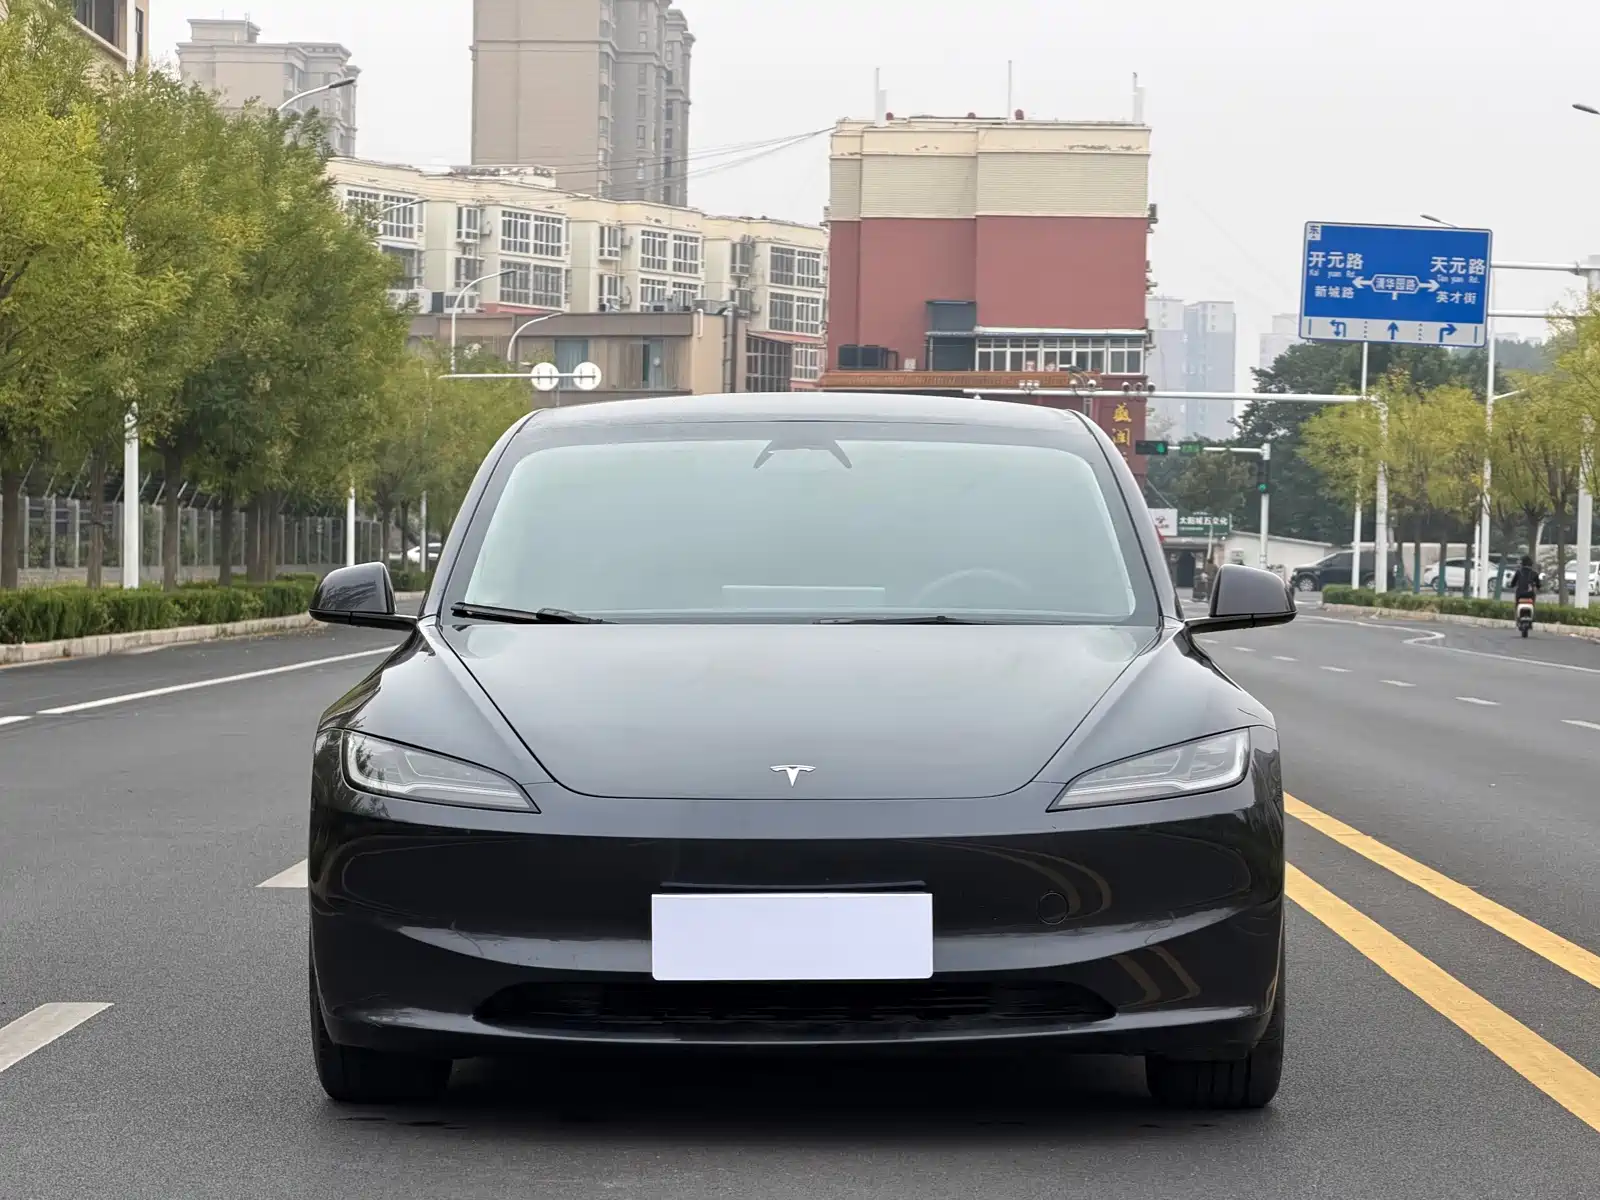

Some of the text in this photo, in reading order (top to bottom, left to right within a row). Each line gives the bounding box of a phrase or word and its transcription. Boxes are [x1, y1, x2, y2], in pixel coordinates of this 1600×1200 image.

[1308, 251, 1364, 270] 开元路
[1430, 256, 1486, 275] 天元路
[1314, 285, 1354, 299] 新城路
[1435, 290, 1477, 305] 英才街
